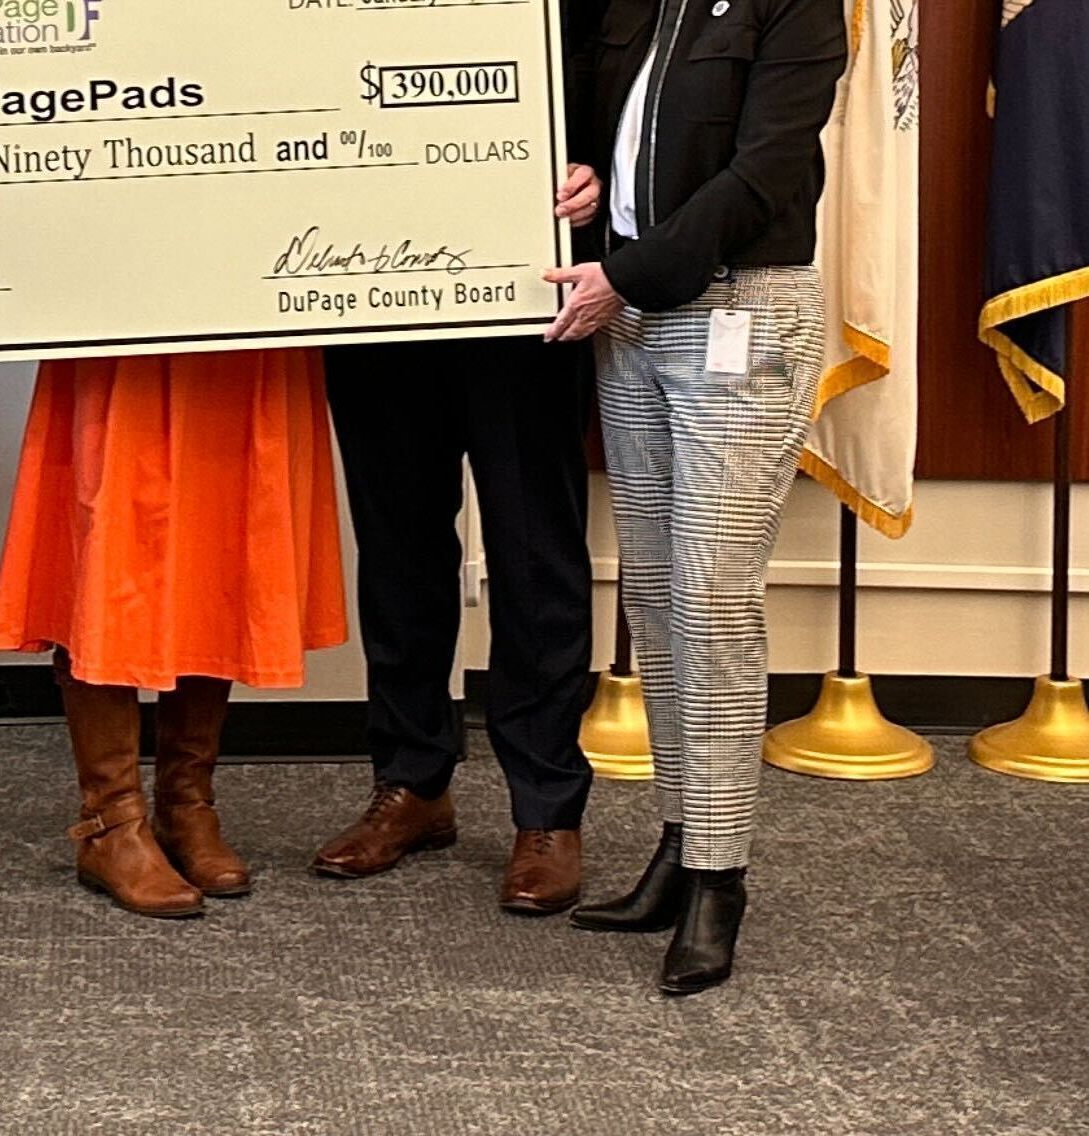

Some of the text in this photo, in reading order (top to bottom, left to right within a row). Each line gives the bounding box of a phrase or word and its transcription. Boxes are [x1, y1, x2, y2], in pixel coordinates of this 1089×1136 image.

[391, 68, 509, 99] 390,000
[104, 133, 256, 169] Thousand
[276, 132, 329, 162] and
[425, 140, 530, 164] DOLLARS
[278, 280, 516, 317] DuPage County Board
